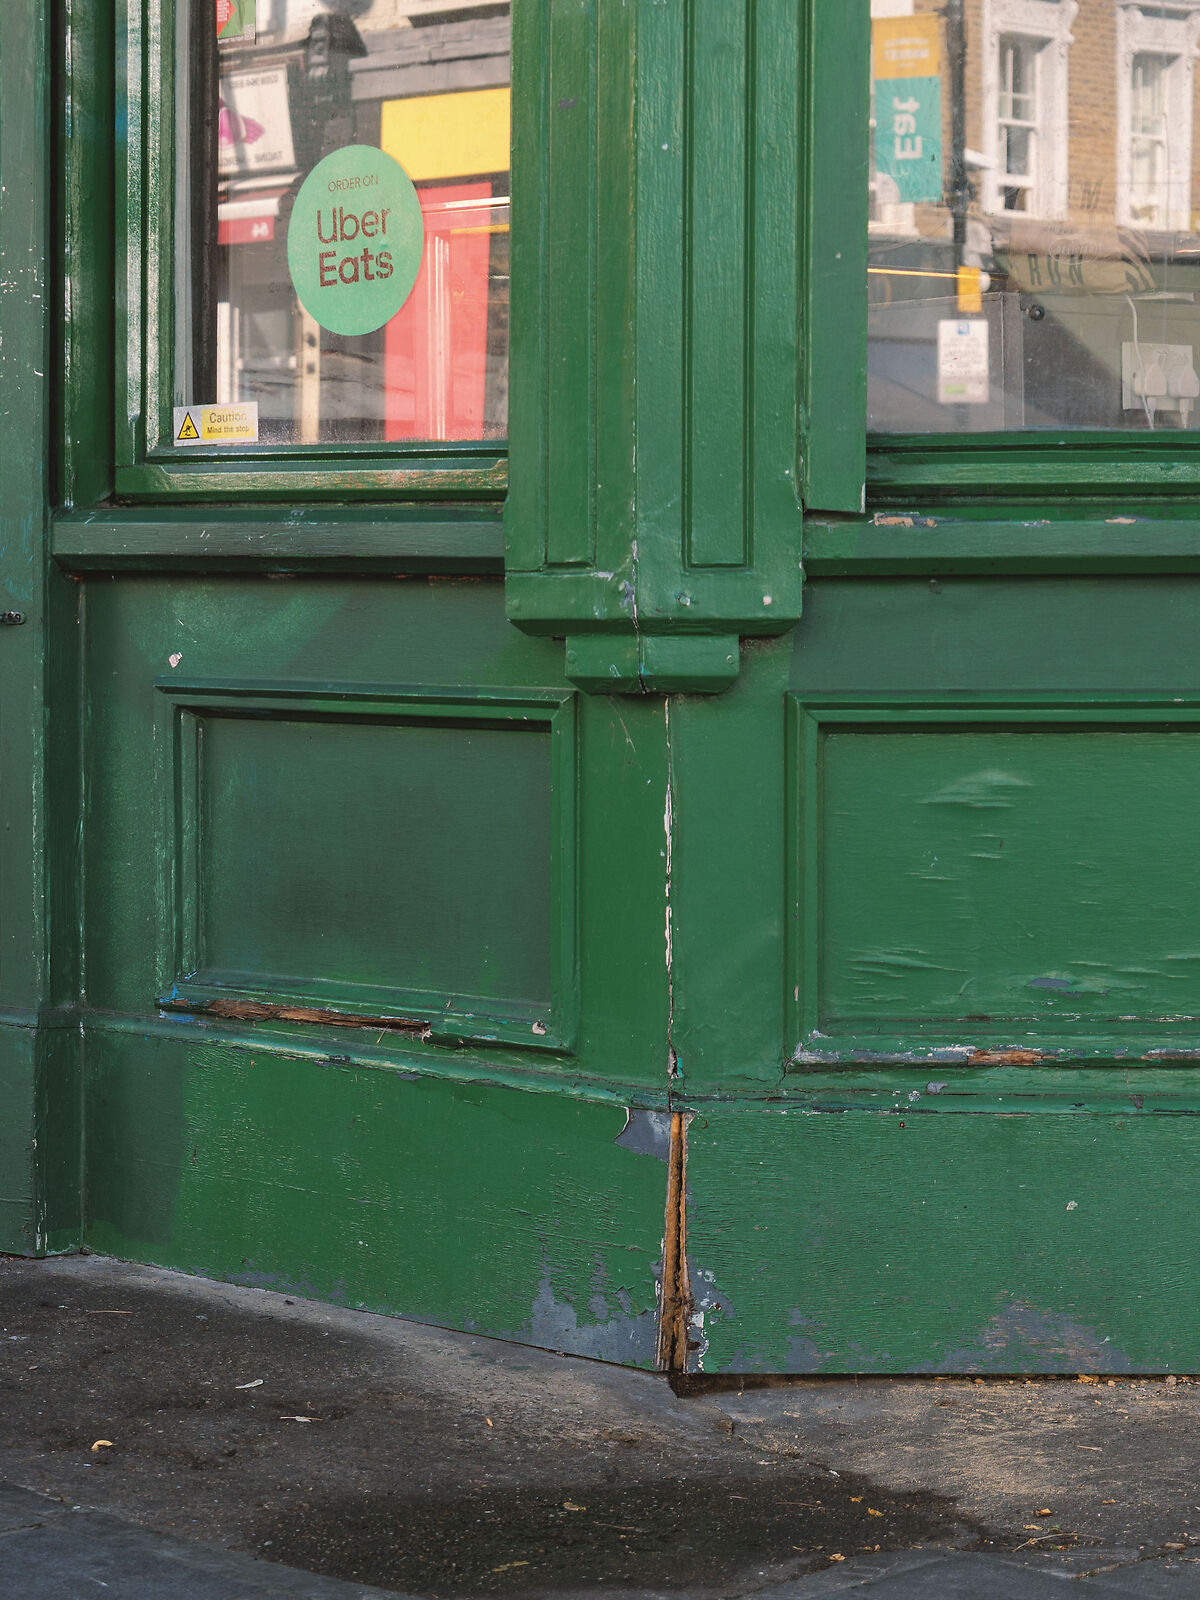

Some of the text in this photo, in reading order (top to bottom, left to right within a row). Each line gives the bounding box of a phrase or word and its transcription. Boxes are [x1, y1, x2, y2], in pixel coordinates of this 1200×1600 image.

[327, 173, 379, 193] ORDER ON
[316, 206, 391, 244] Uber
[319, 247, 394, 287] Eats
[209, 411, 248, 424] Caution
[207, 425, 222, 434] Mind
[235, 425, 250, 433] step
